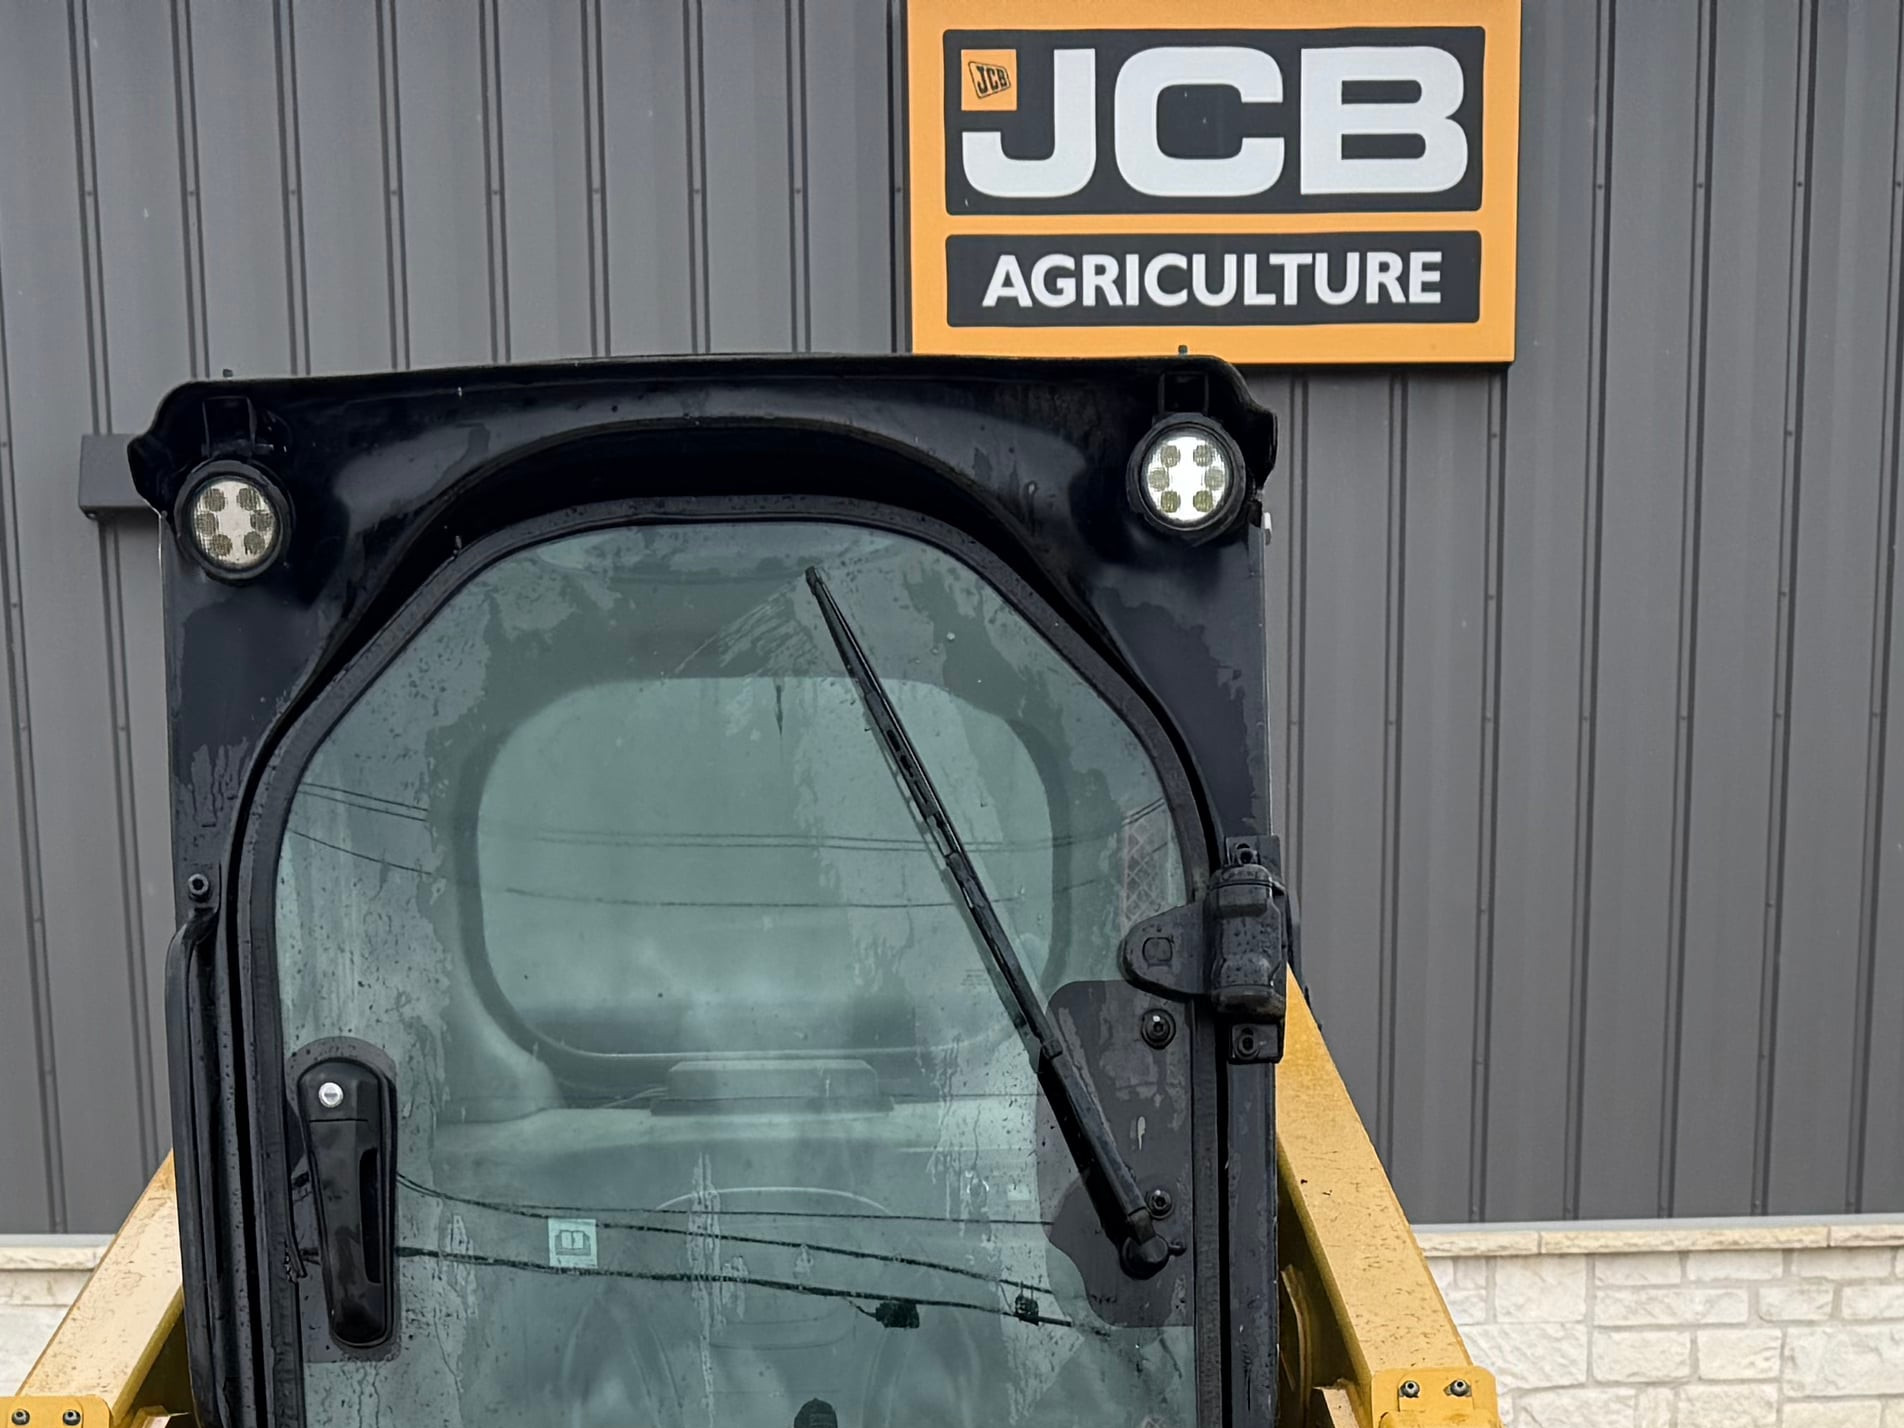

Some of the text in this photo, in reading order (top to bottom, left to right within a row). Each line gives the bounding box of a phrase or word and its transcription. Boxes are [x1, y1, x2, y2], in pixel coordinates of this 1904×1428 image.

[975, 65, 1008, 95] JCB
[962, 46, 1469, 198] JCB
[981, 250, 1443, 309] AGRICULTURE
